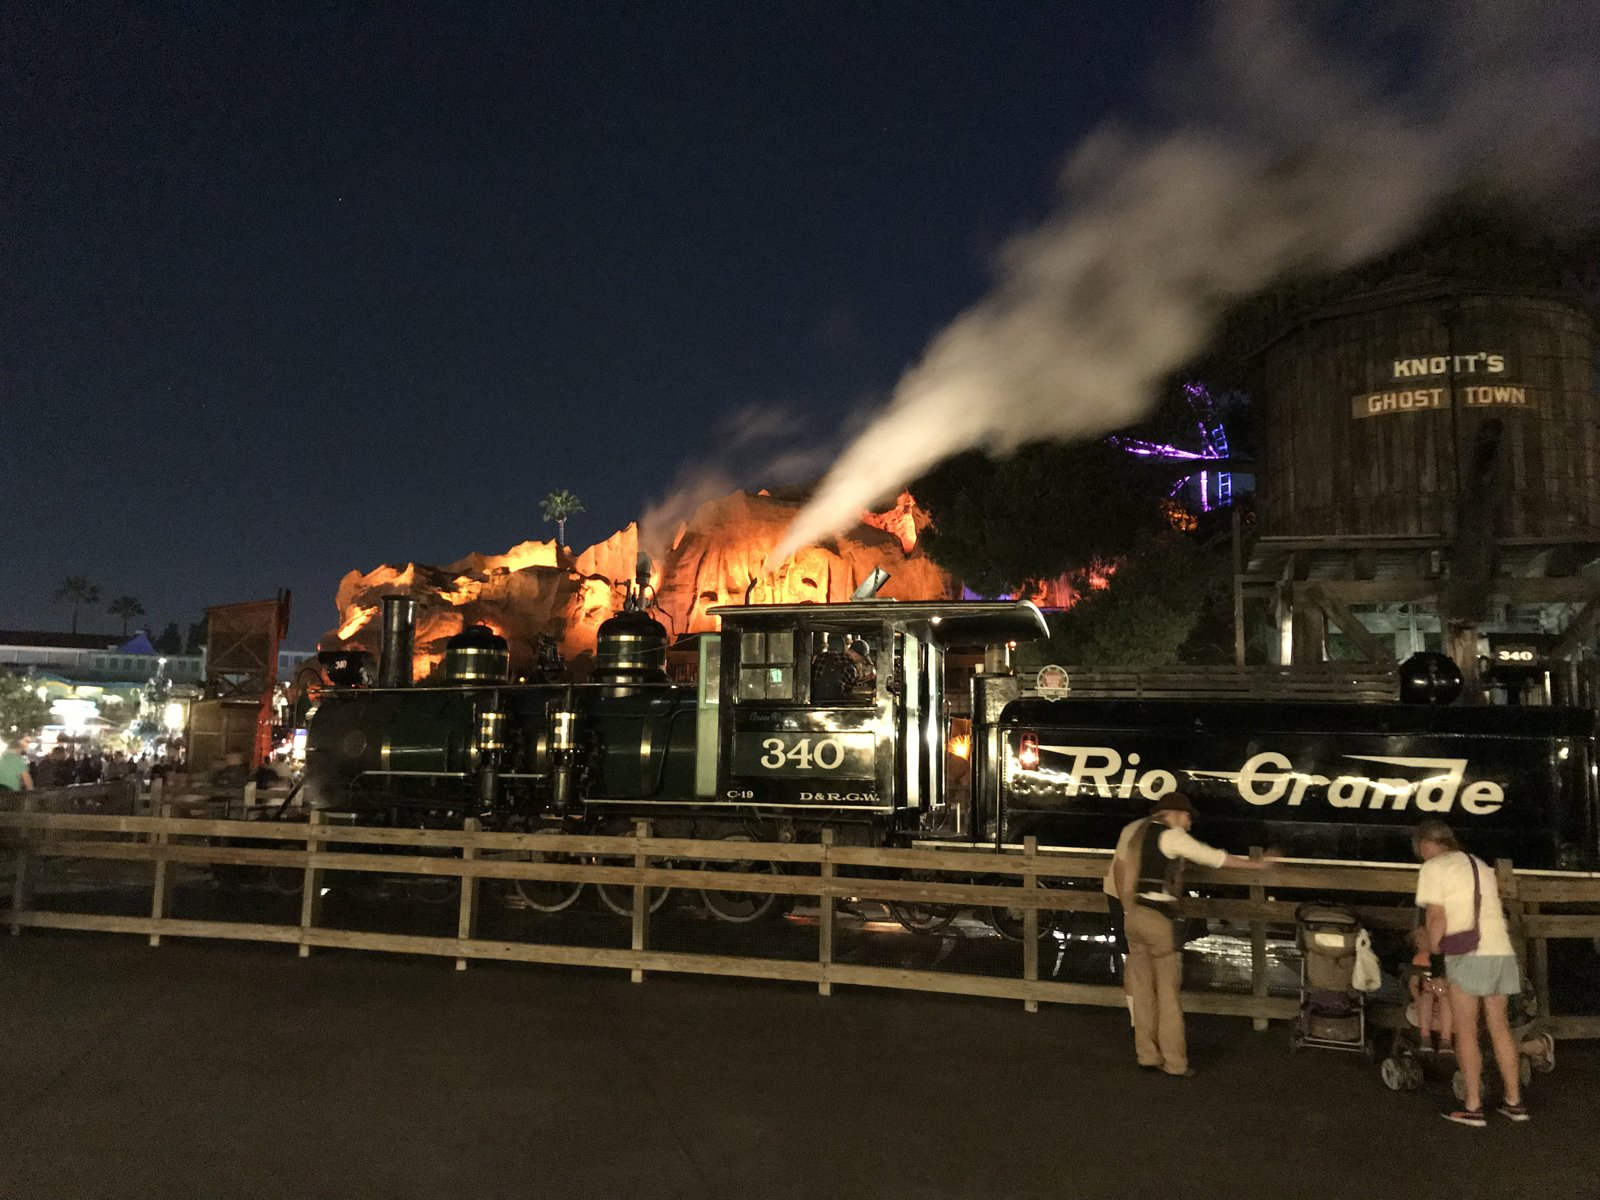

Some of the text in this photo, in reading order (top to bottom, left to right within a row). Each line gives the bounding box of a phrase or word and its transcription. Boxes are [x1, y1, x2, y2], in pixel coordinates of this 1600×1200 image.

[1367, 386, 1526, 413] GHOST TOWN
[1499, 651, 1533, 661] 340
[760, 738, 845, 770] 340
[1036, 744, 1504, 815] Rio Grande
[726, 790, 754, 799] C-19
